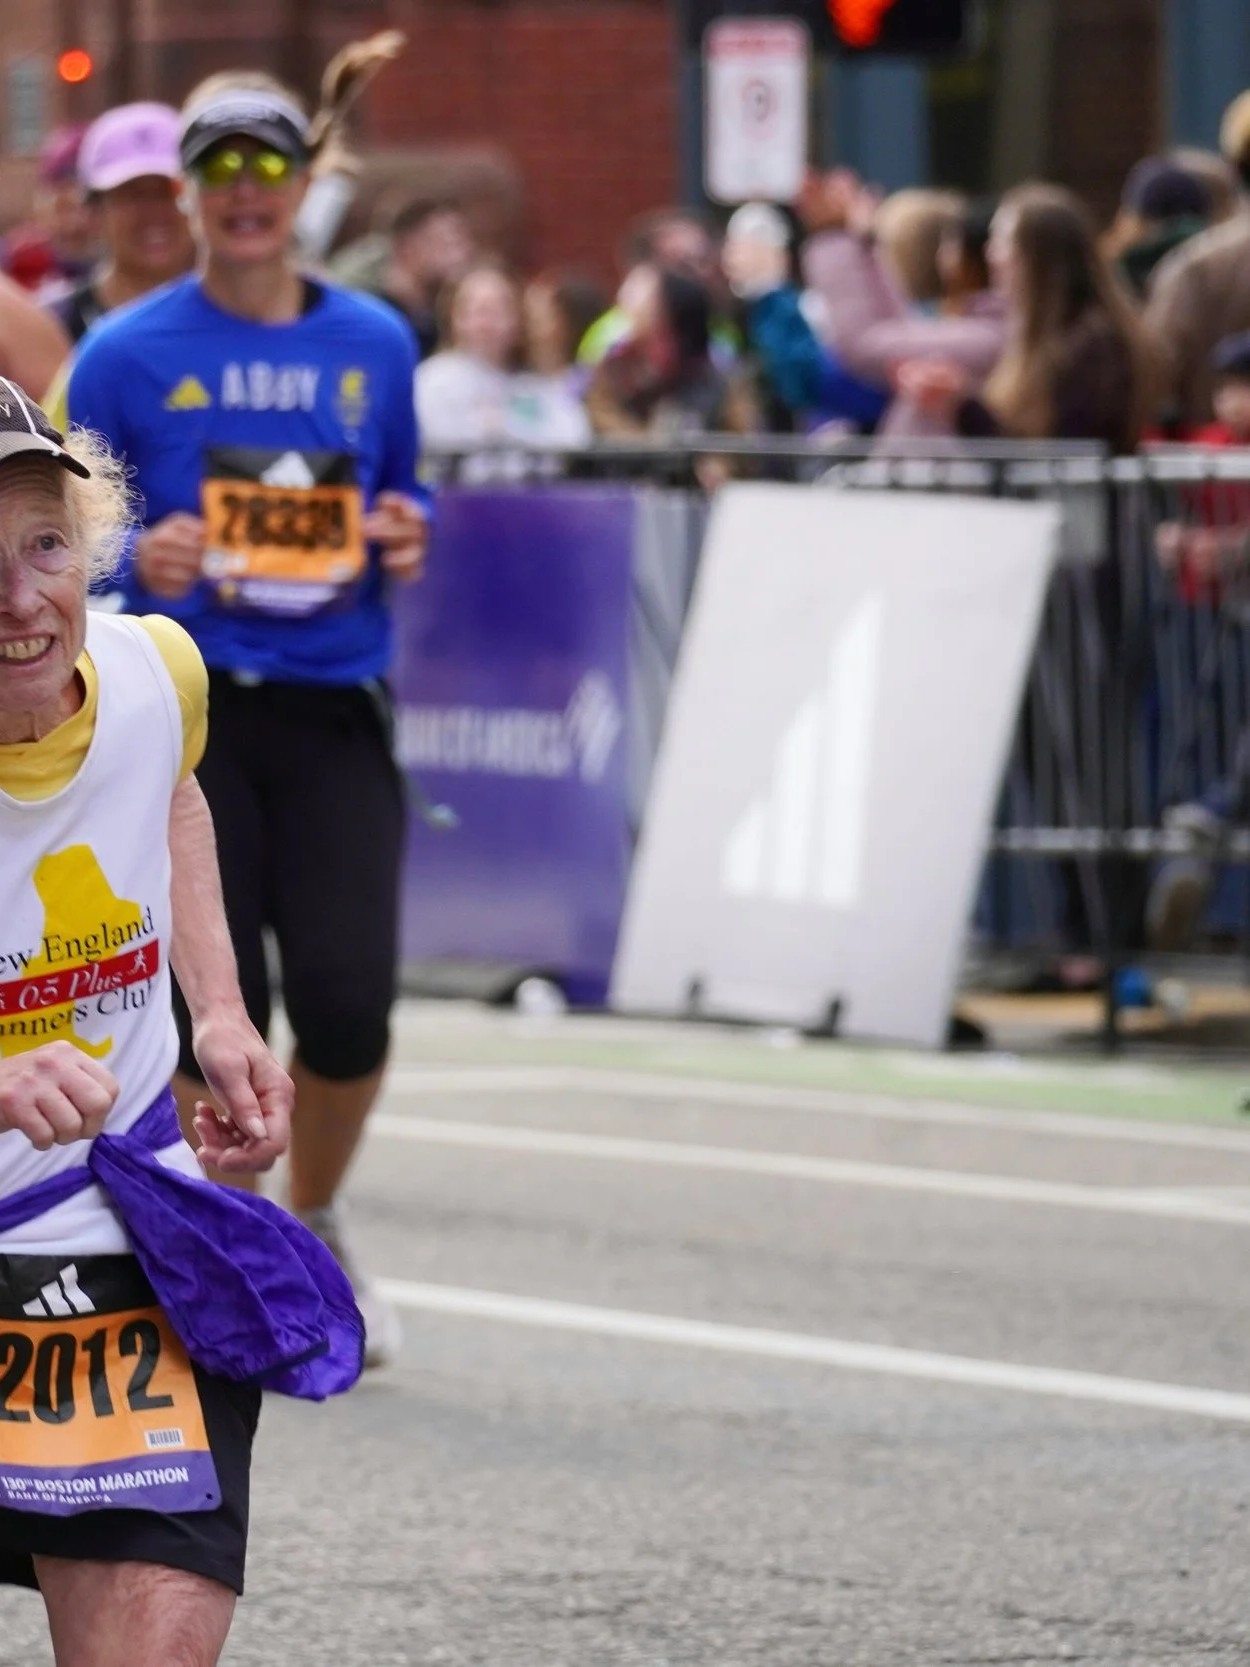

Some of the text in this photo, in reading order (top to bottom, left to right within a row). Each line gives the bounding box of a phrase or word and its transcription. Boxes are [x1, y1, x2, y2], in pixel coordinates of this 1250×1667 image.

[42, 904, 155, 964] England
[68, 963, 123, 998] Plus
[7, 1490, 40, 1500] BANK
[33, 1477, 97, 1494] BOSTON
[100, 1466, 189, 1492] MARATHON
